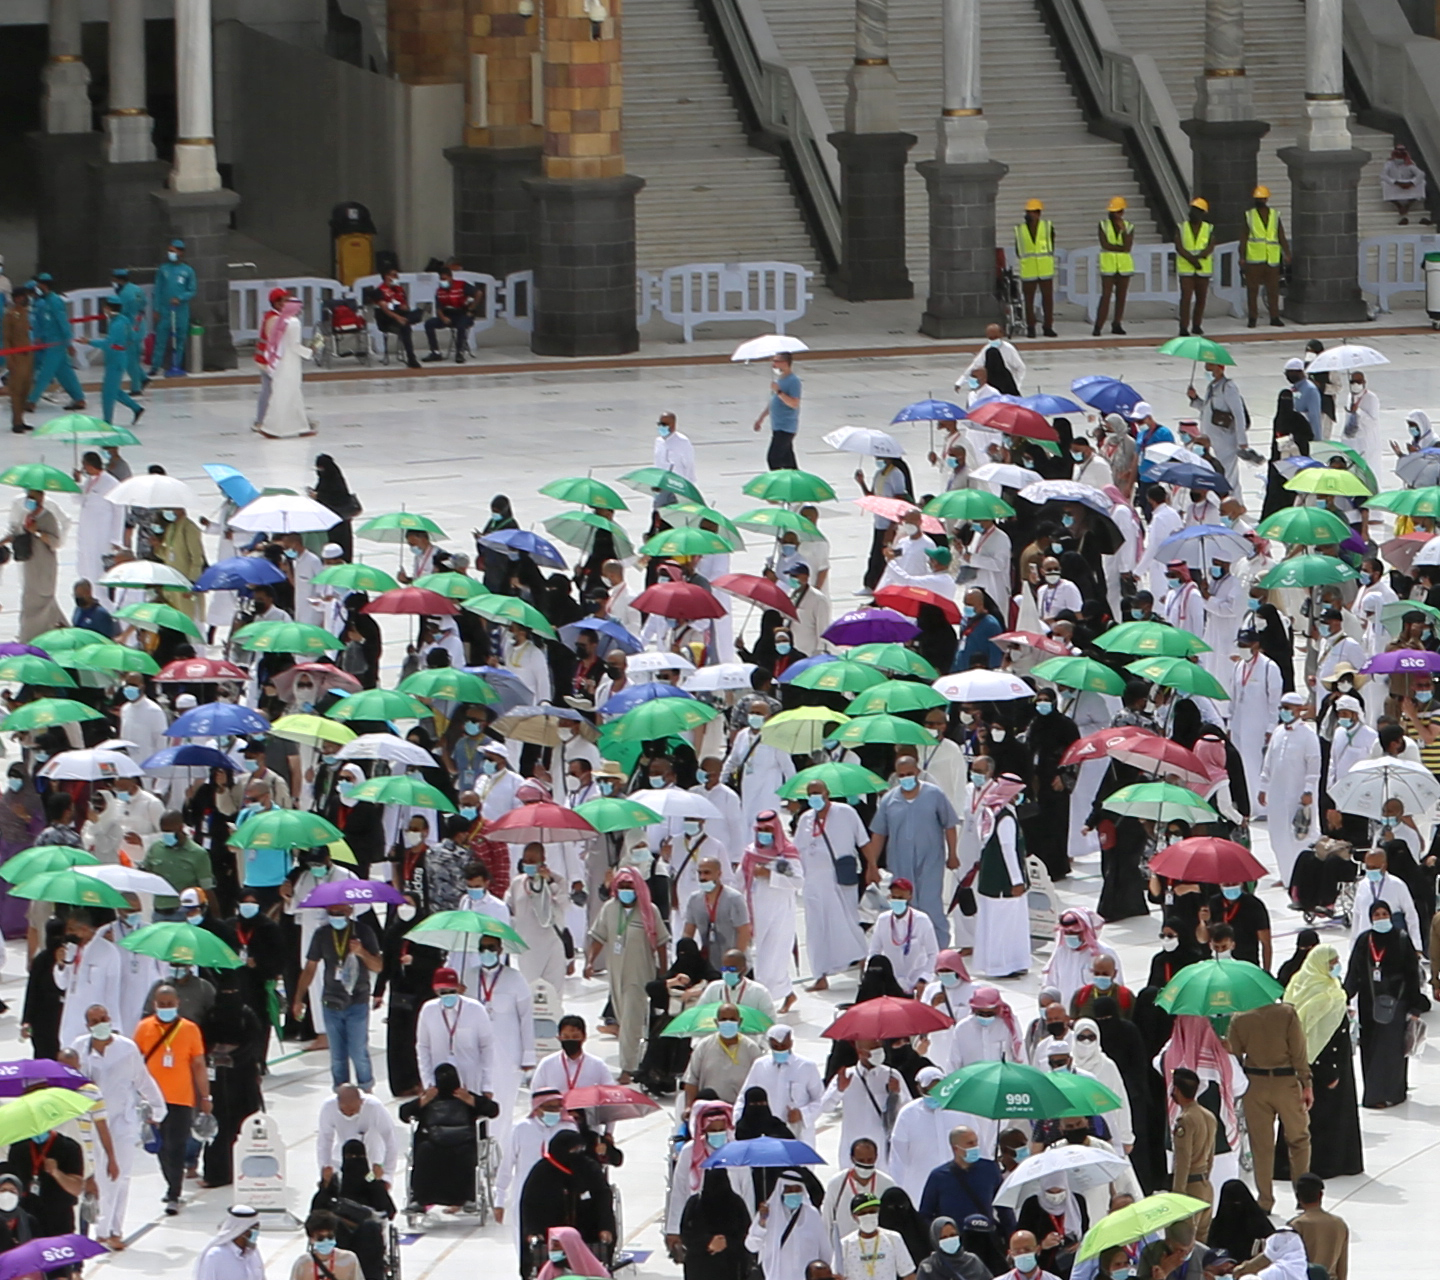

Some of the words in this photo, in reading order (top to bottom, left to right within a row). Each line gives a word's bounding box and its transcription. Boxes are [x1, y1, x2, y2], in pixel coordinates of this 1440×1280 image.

[1400, 656, 1425, 667] stc
[345, 886, 373, 900] stc
[1005, 1091, 1031, 1105] 990
[42, 1244, 75, 1261] stc
